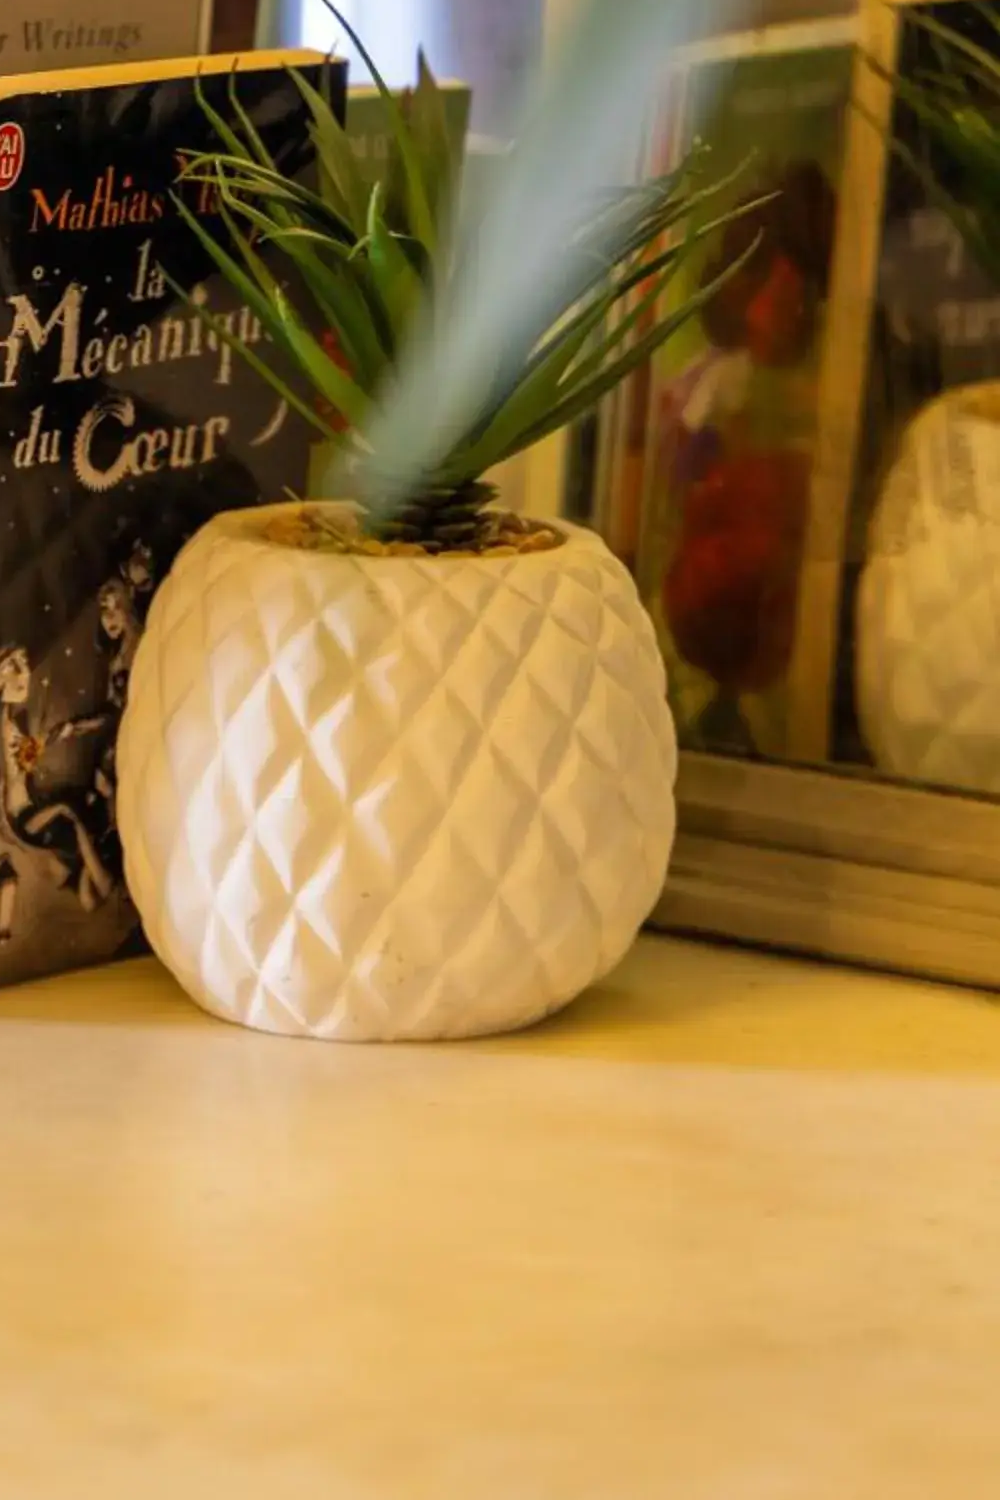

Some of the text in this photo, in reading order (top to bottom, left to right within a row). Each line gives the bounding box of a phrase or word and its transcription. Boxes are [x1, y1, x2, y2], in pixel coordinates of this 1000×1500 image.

[23, 18, 144, 58] Writings
[29, 166, 165, 233] Mathias
[127, 238, 167, 302] la
[13, 404, 62, 468] du
